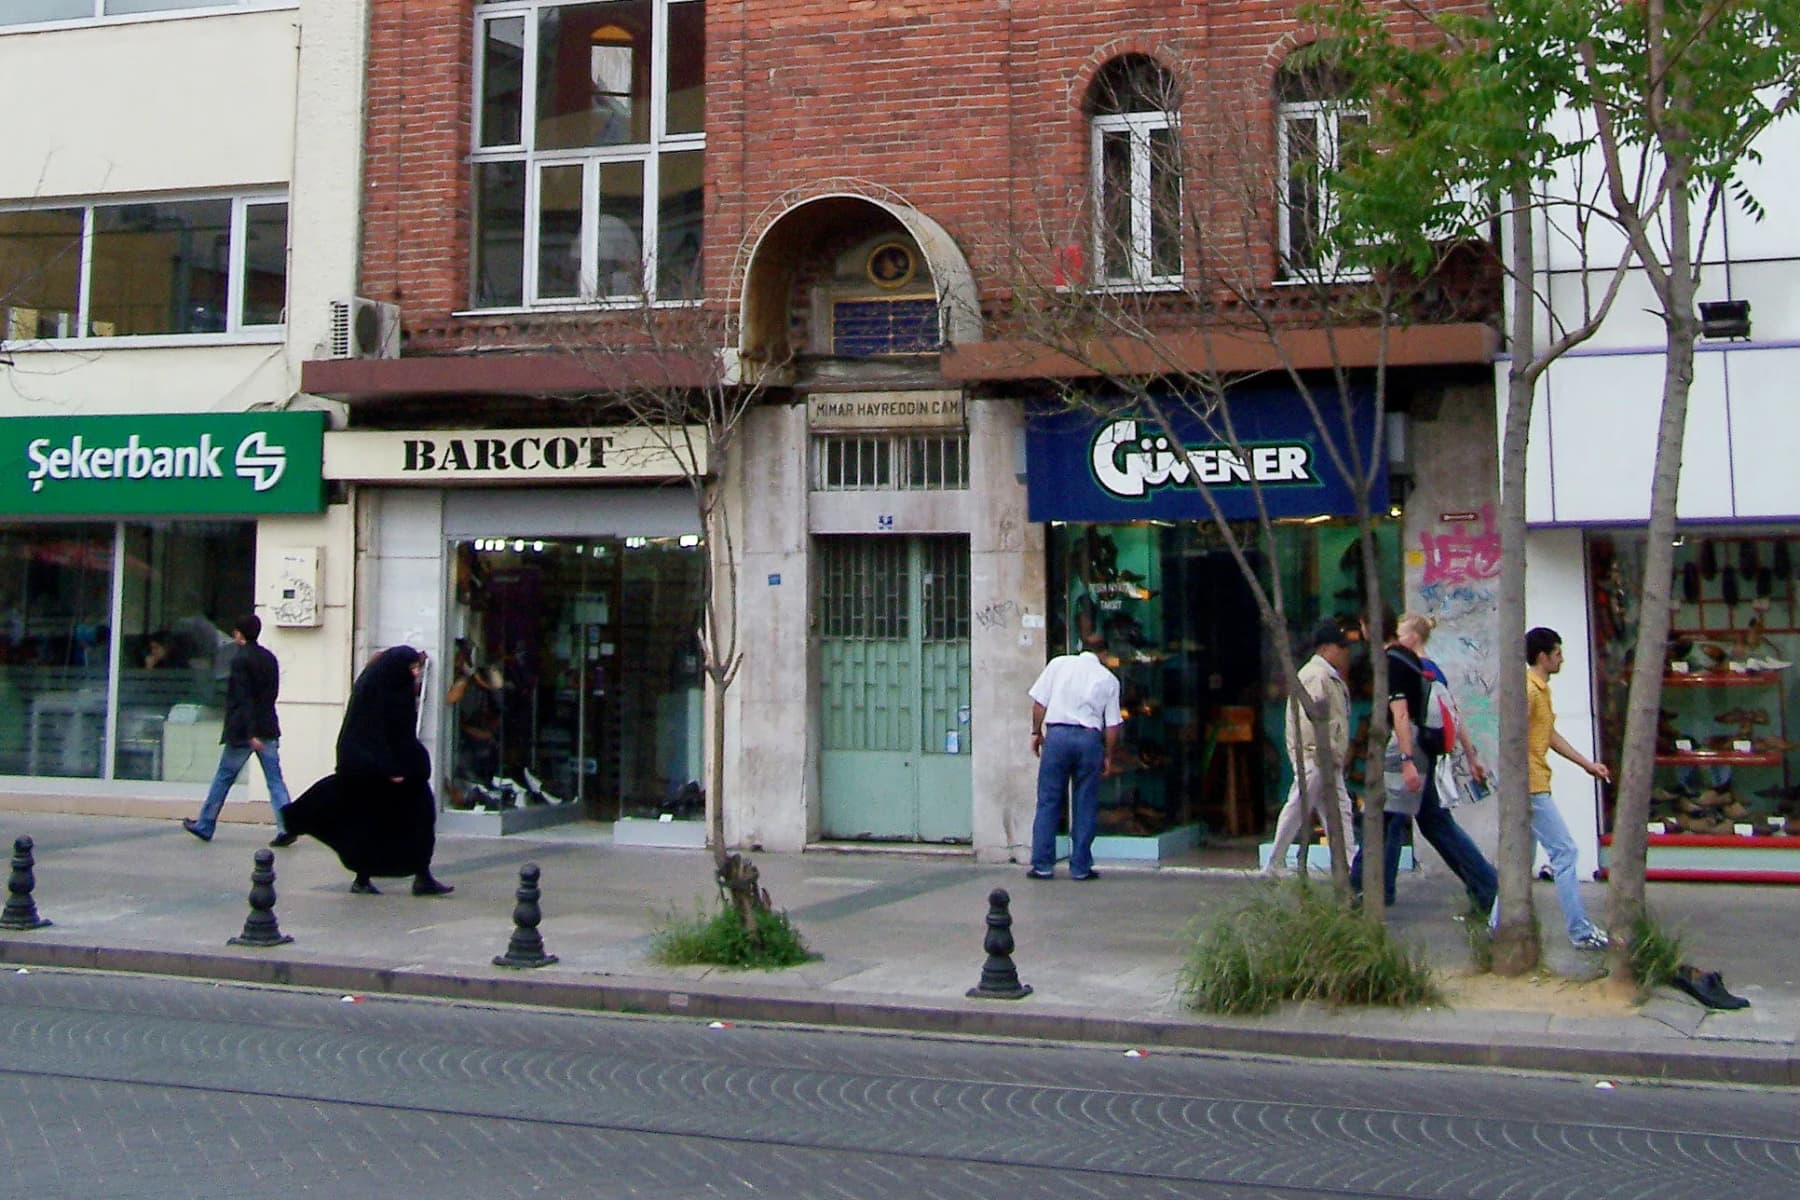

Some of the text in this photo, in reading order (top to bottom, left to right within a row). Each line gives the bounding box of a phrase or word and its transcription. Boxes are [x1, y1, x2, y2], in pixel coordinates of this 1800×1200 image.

[28, 433, 224, 492] Şekerbank
[402, 436, 614, 471] BARCOT
[1093, 420, 1309, 496] GÜVENER
